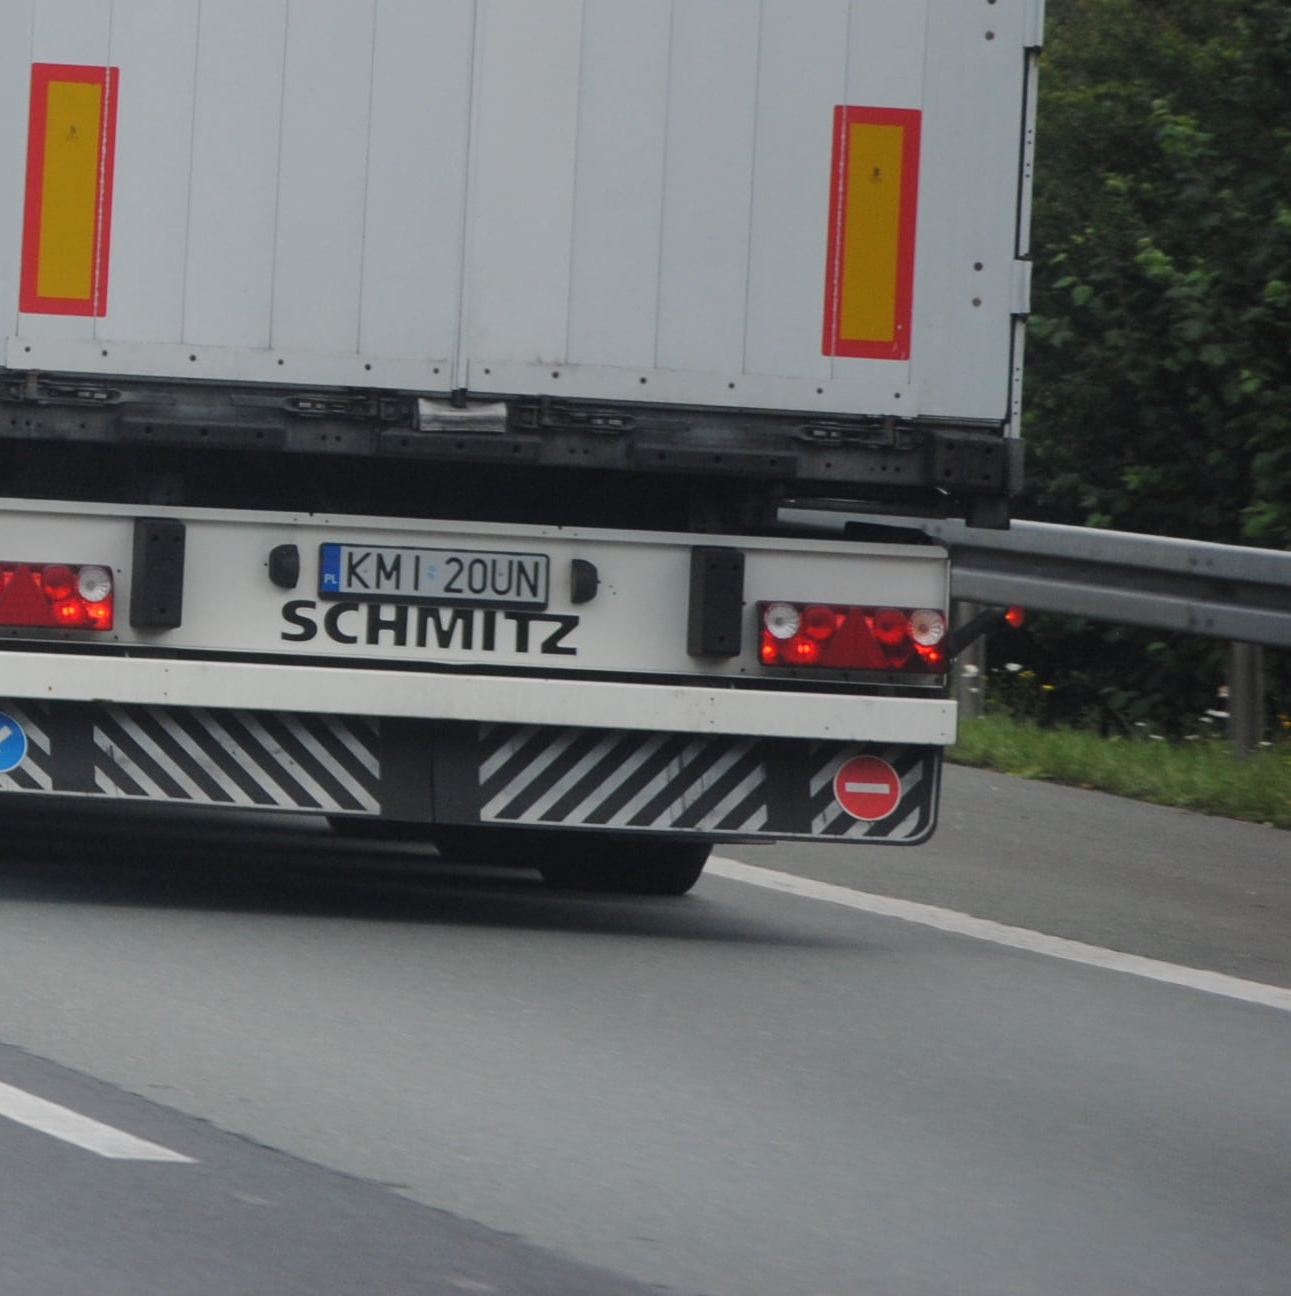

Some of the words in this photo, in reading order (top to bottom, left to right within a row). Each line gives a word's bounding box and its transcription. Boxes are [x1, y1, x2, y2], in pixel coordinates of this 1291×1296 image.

[324, 572, 338, 585] PL
[443, 556, 540, 598] 20UN
[281, 599, 580, 656] SCHMITZ
